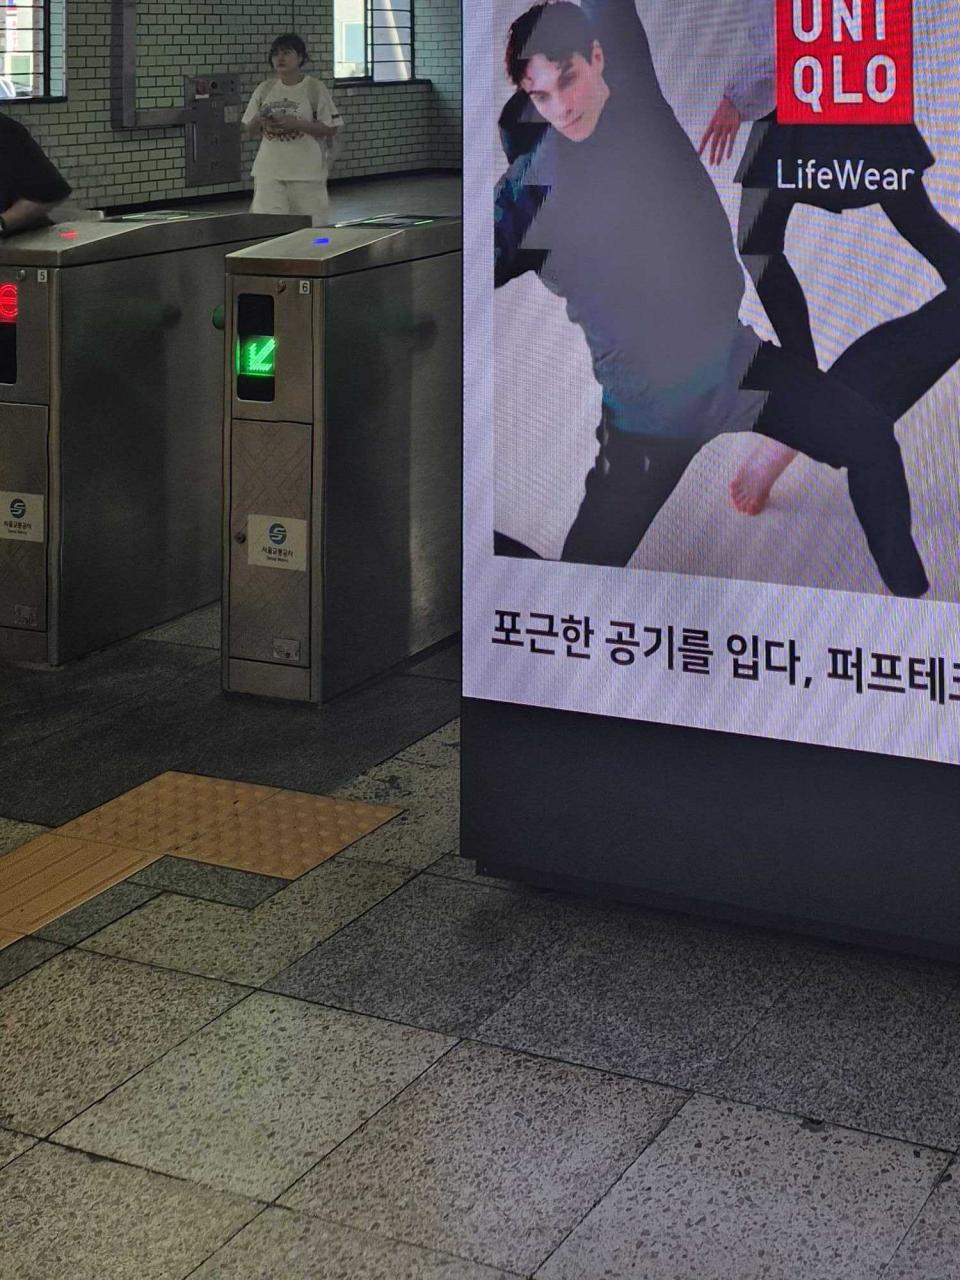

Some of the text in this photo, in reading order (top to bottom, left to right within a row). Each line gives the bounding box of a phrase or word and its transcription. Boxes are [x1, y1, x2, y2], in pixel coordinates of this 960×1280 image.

[793, 54, 897, 113] QLO
[776, 158, 915, 191] LifeWear
[492, 609, 594, 659] 포근한
[605, 620, 713, 675] 공기를
[726, 634, 812, 688] 입다,
